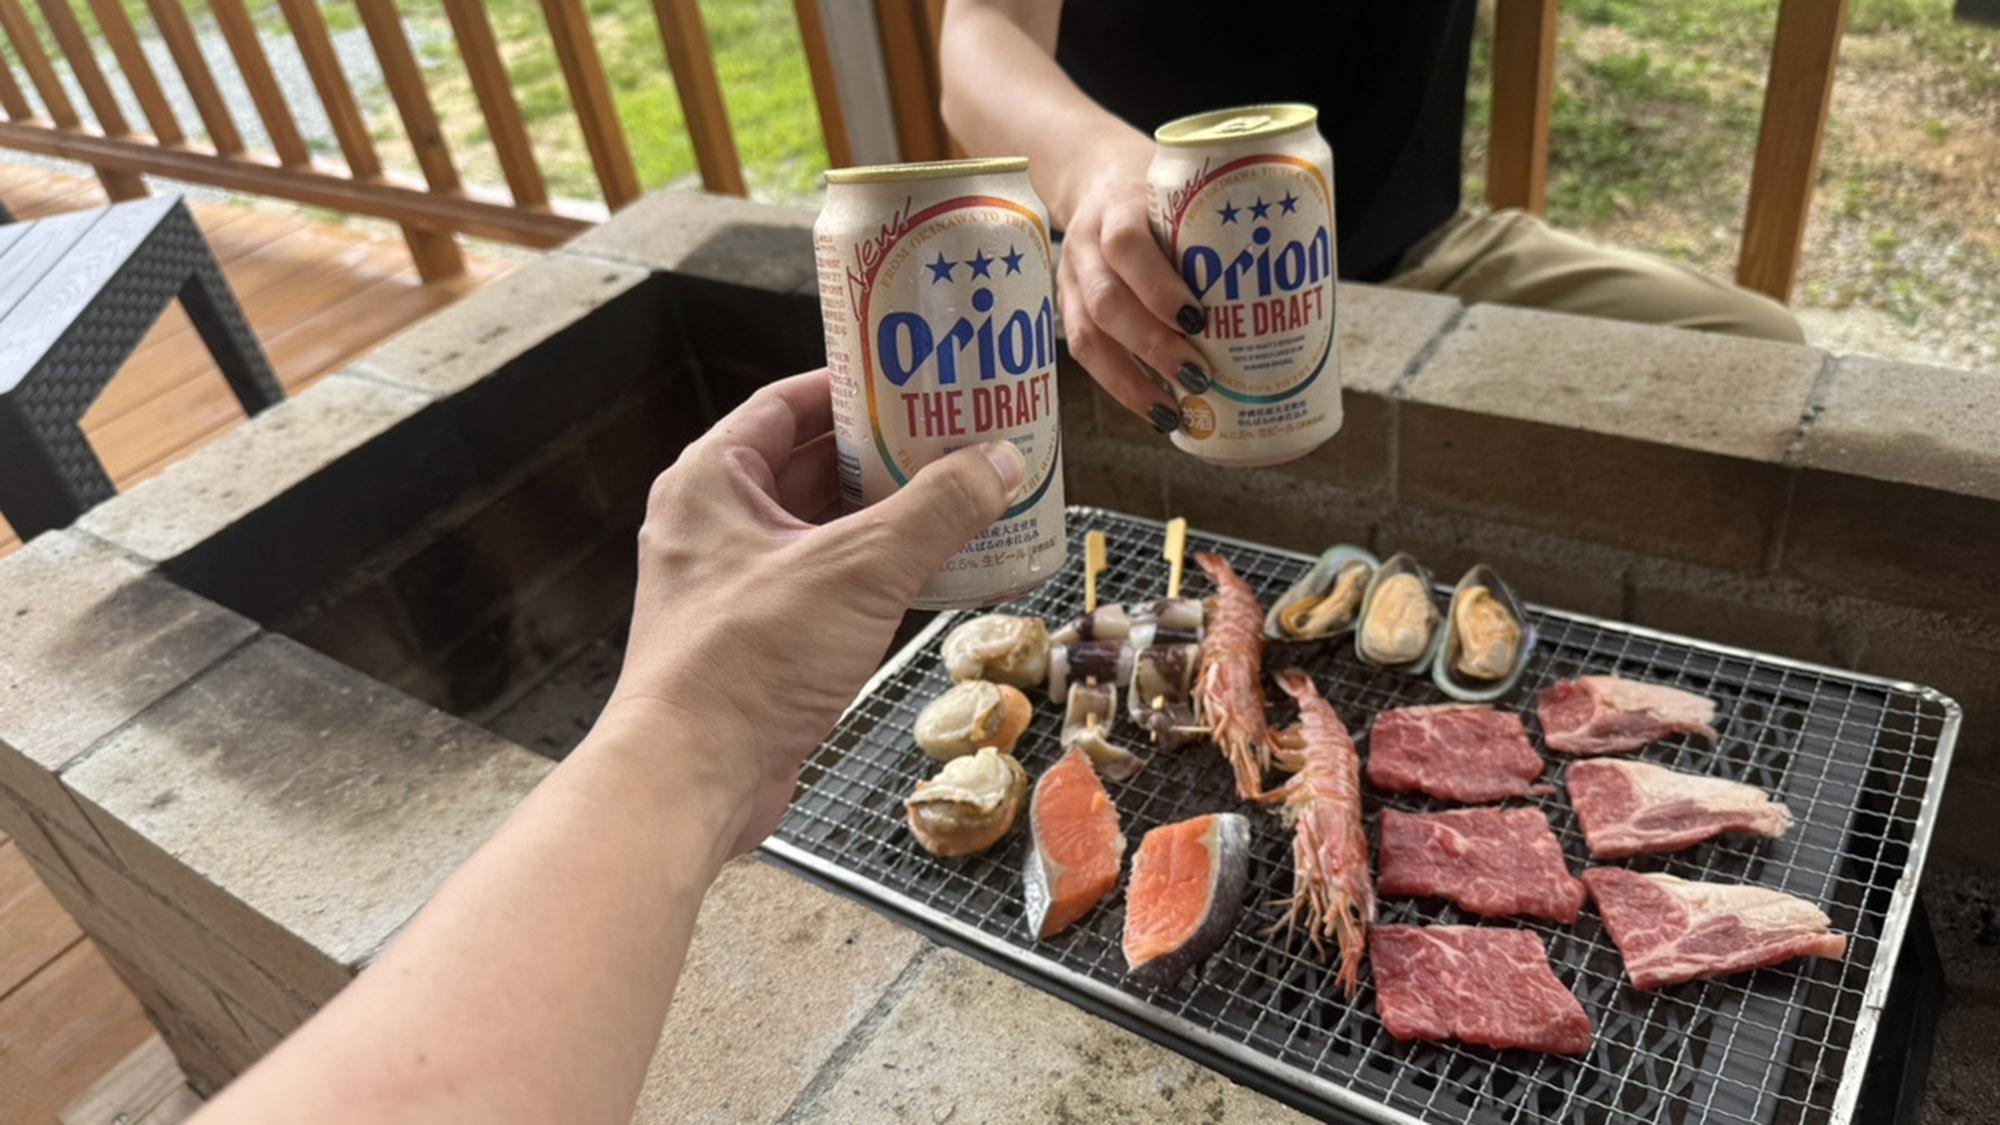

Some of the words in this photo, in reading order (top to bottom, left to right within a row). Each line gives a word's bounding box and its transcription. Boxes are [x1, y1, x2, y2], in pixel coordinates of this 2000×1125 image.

[846, 195, 912, 323] New!
[880, 246, 911, 289] FROM
[909, 212, 977, 249] OKINAWA
[981, 210, 1001, 223] TO
[1005, 212, 1027, 233] THE
[1203, 304, 1247, 340] THE
[1252, 286, 1324, 337] DRAFT
[901, 390, 966, 438] THE
[972, 372, 1051, 434] DRAFT
[897, 447, 921, 478] FRO
[1022, 472, 1041, 494] THE
[982, 548, 1026, 569] 生ビール
